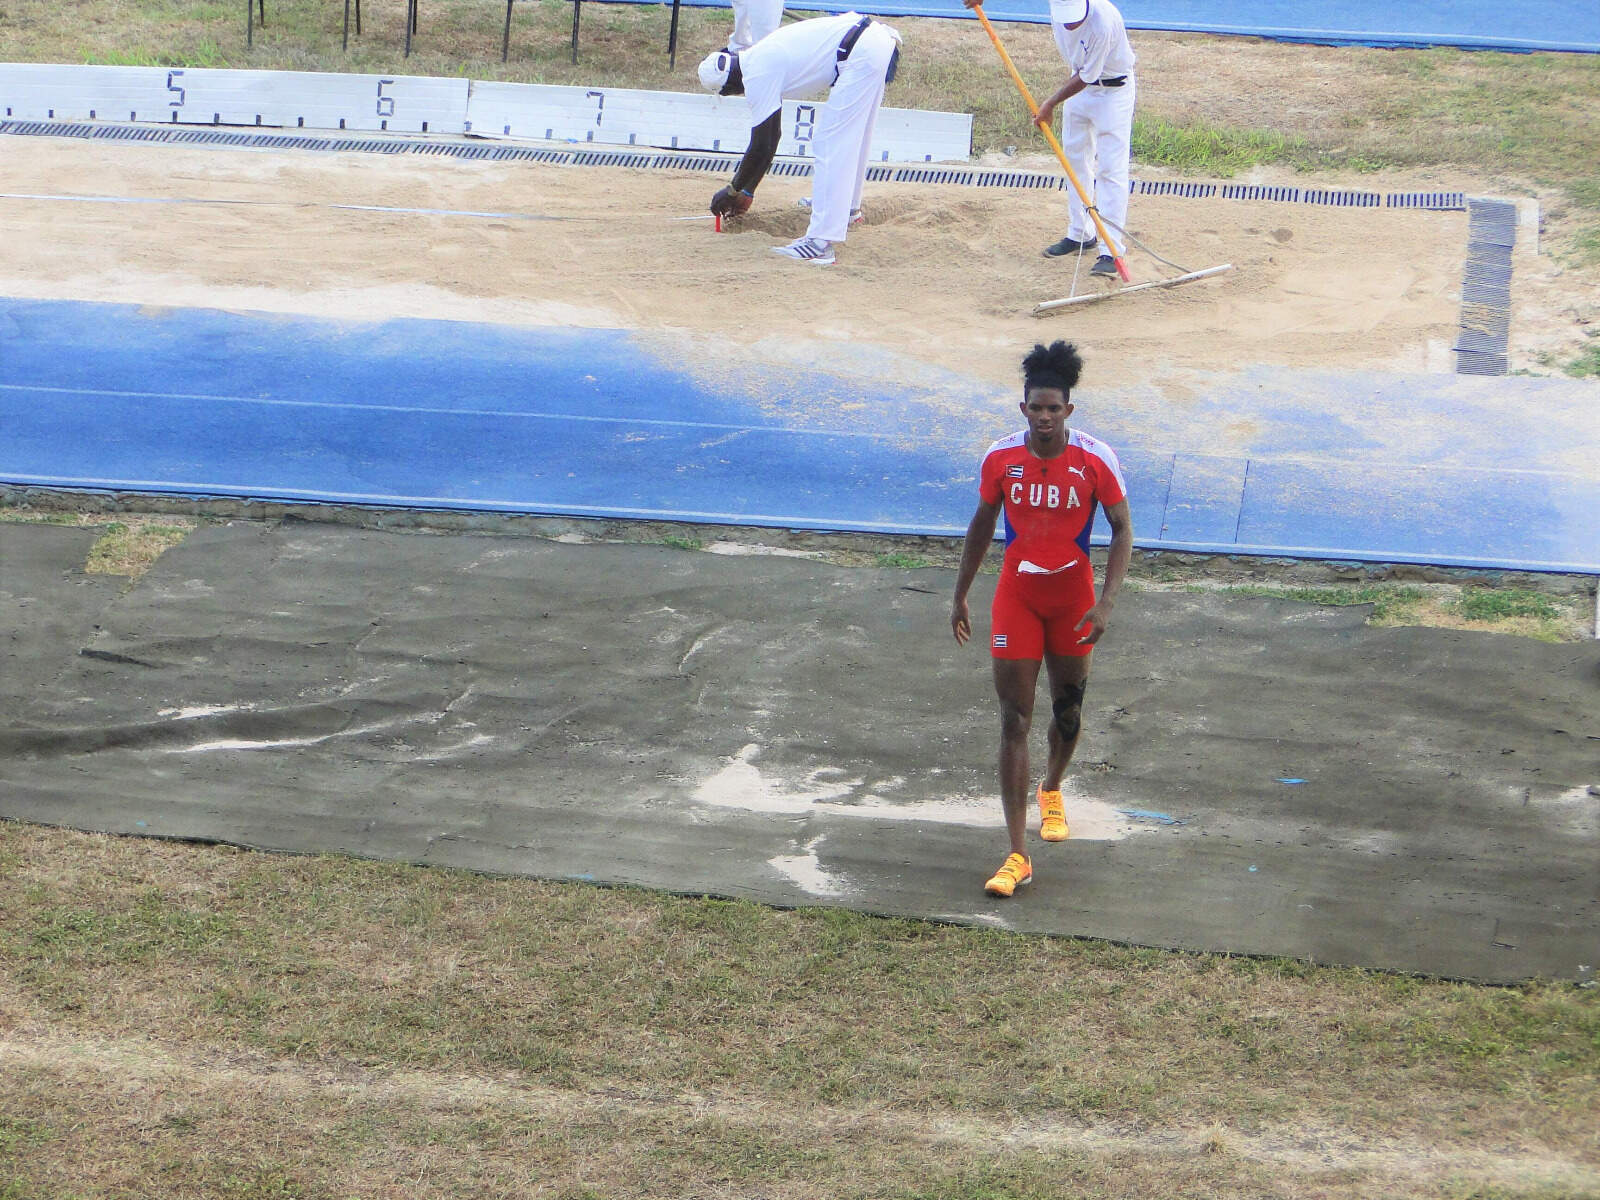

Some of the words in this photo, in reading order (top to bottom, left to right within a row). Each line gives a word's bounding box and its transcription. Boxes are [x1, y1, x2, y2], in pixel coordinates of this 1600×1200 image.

[167, 70, 185, 106] 5
[377, 80, 394, 117] 6
[586, 91, 604, 127] 7
[794, 105, 815, 141] 8
[1010, 482, 1081, 509] CUBA
